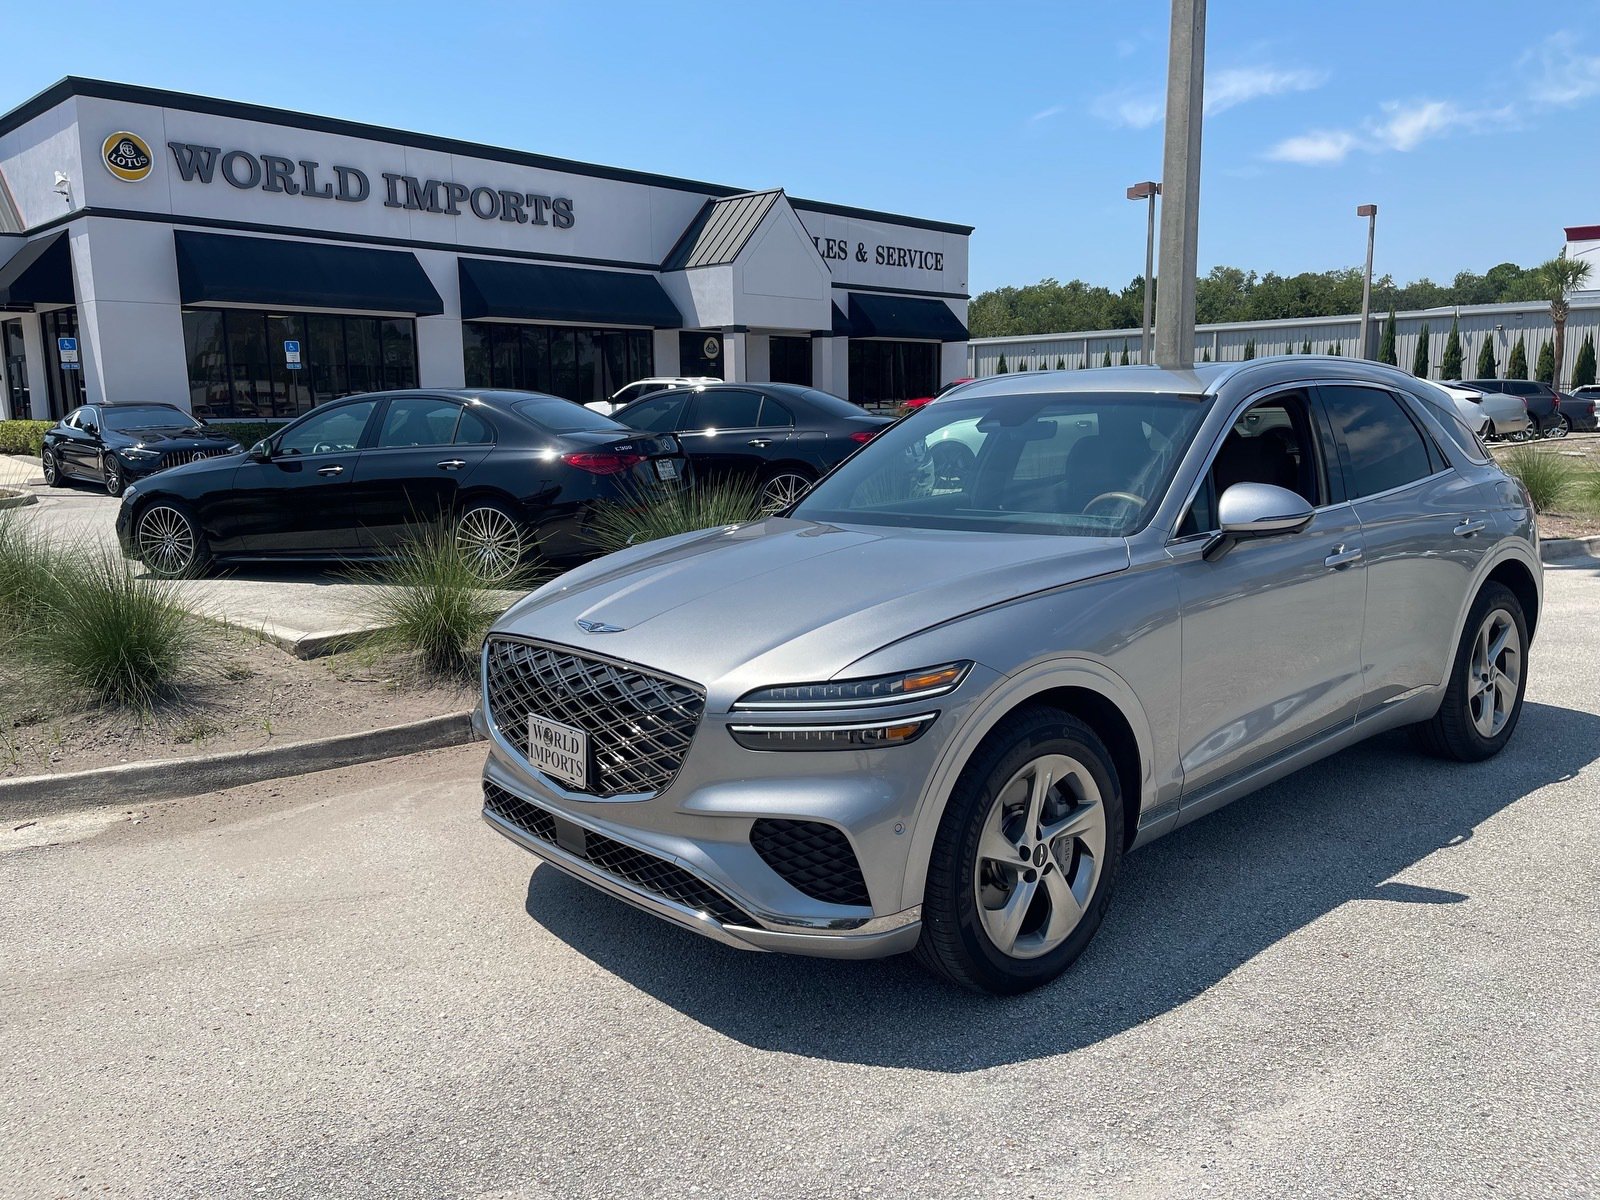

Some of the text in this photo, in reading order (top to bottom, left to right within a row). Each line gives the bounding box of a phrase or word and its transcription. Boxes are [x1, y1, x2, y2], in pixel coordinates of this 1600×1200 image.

[110, 153, 148, 167] LOTUS
[168, 141, 575, 229] WORLD IMPORTS
[813, 236, 944, 271] LES & SERVICE
[533, 724, 579, 754] WORLD
[530, 742, 583, 777] IMPORTS
